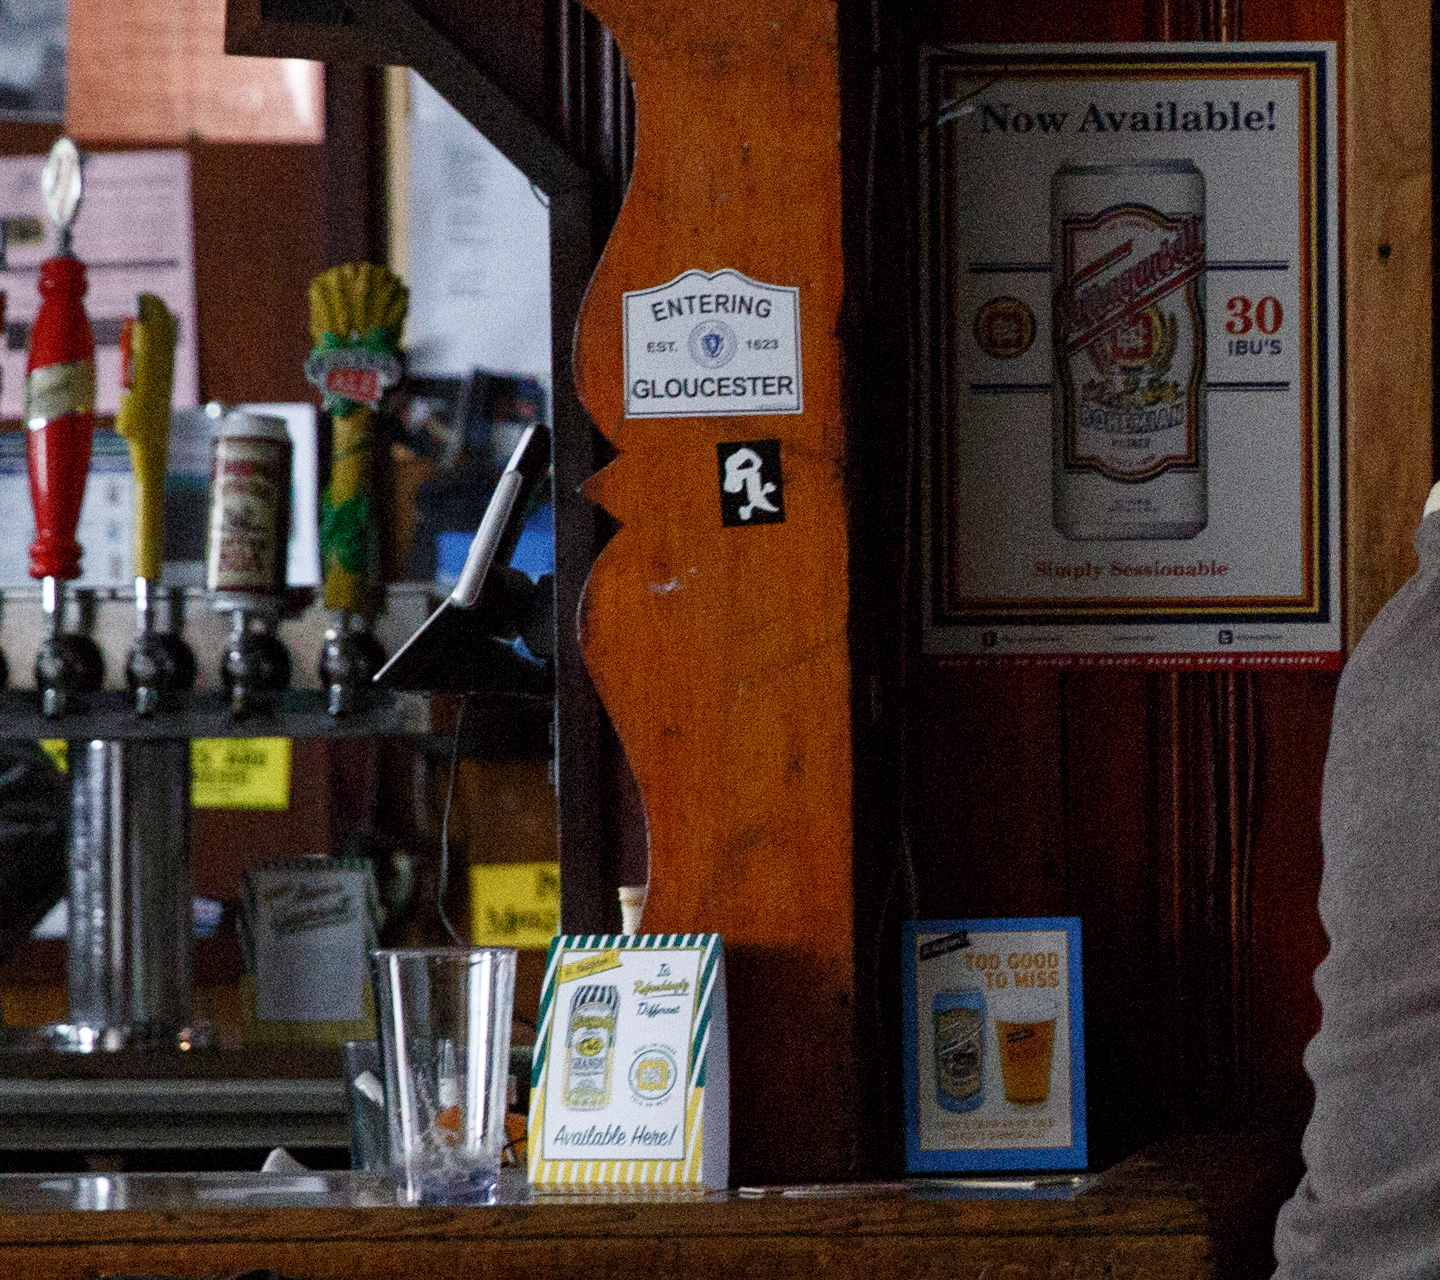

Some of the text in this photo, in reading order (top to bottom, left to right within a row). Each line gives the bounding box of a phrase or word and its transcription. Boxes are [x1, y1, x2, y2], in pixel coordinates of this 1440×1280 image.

[979, 100, 1277, 134] Now Available!
[650, 293, 772, 322] ENTERING
[1225, 295, 1284, 335] 30
[646, 339, 780, 354] EST. 1623
[1227, 338, 1283, 357] IBU'S
[631, 375, 795, 400] GLOUCESTER
[1034, 559, 1229, 581] Simply Sessionable
[965, 952, 1060, 971] TOO GOOD
[985, 971, 1060, 990] TO MISS
[553, 1123, 679, 1147] Available Here!
